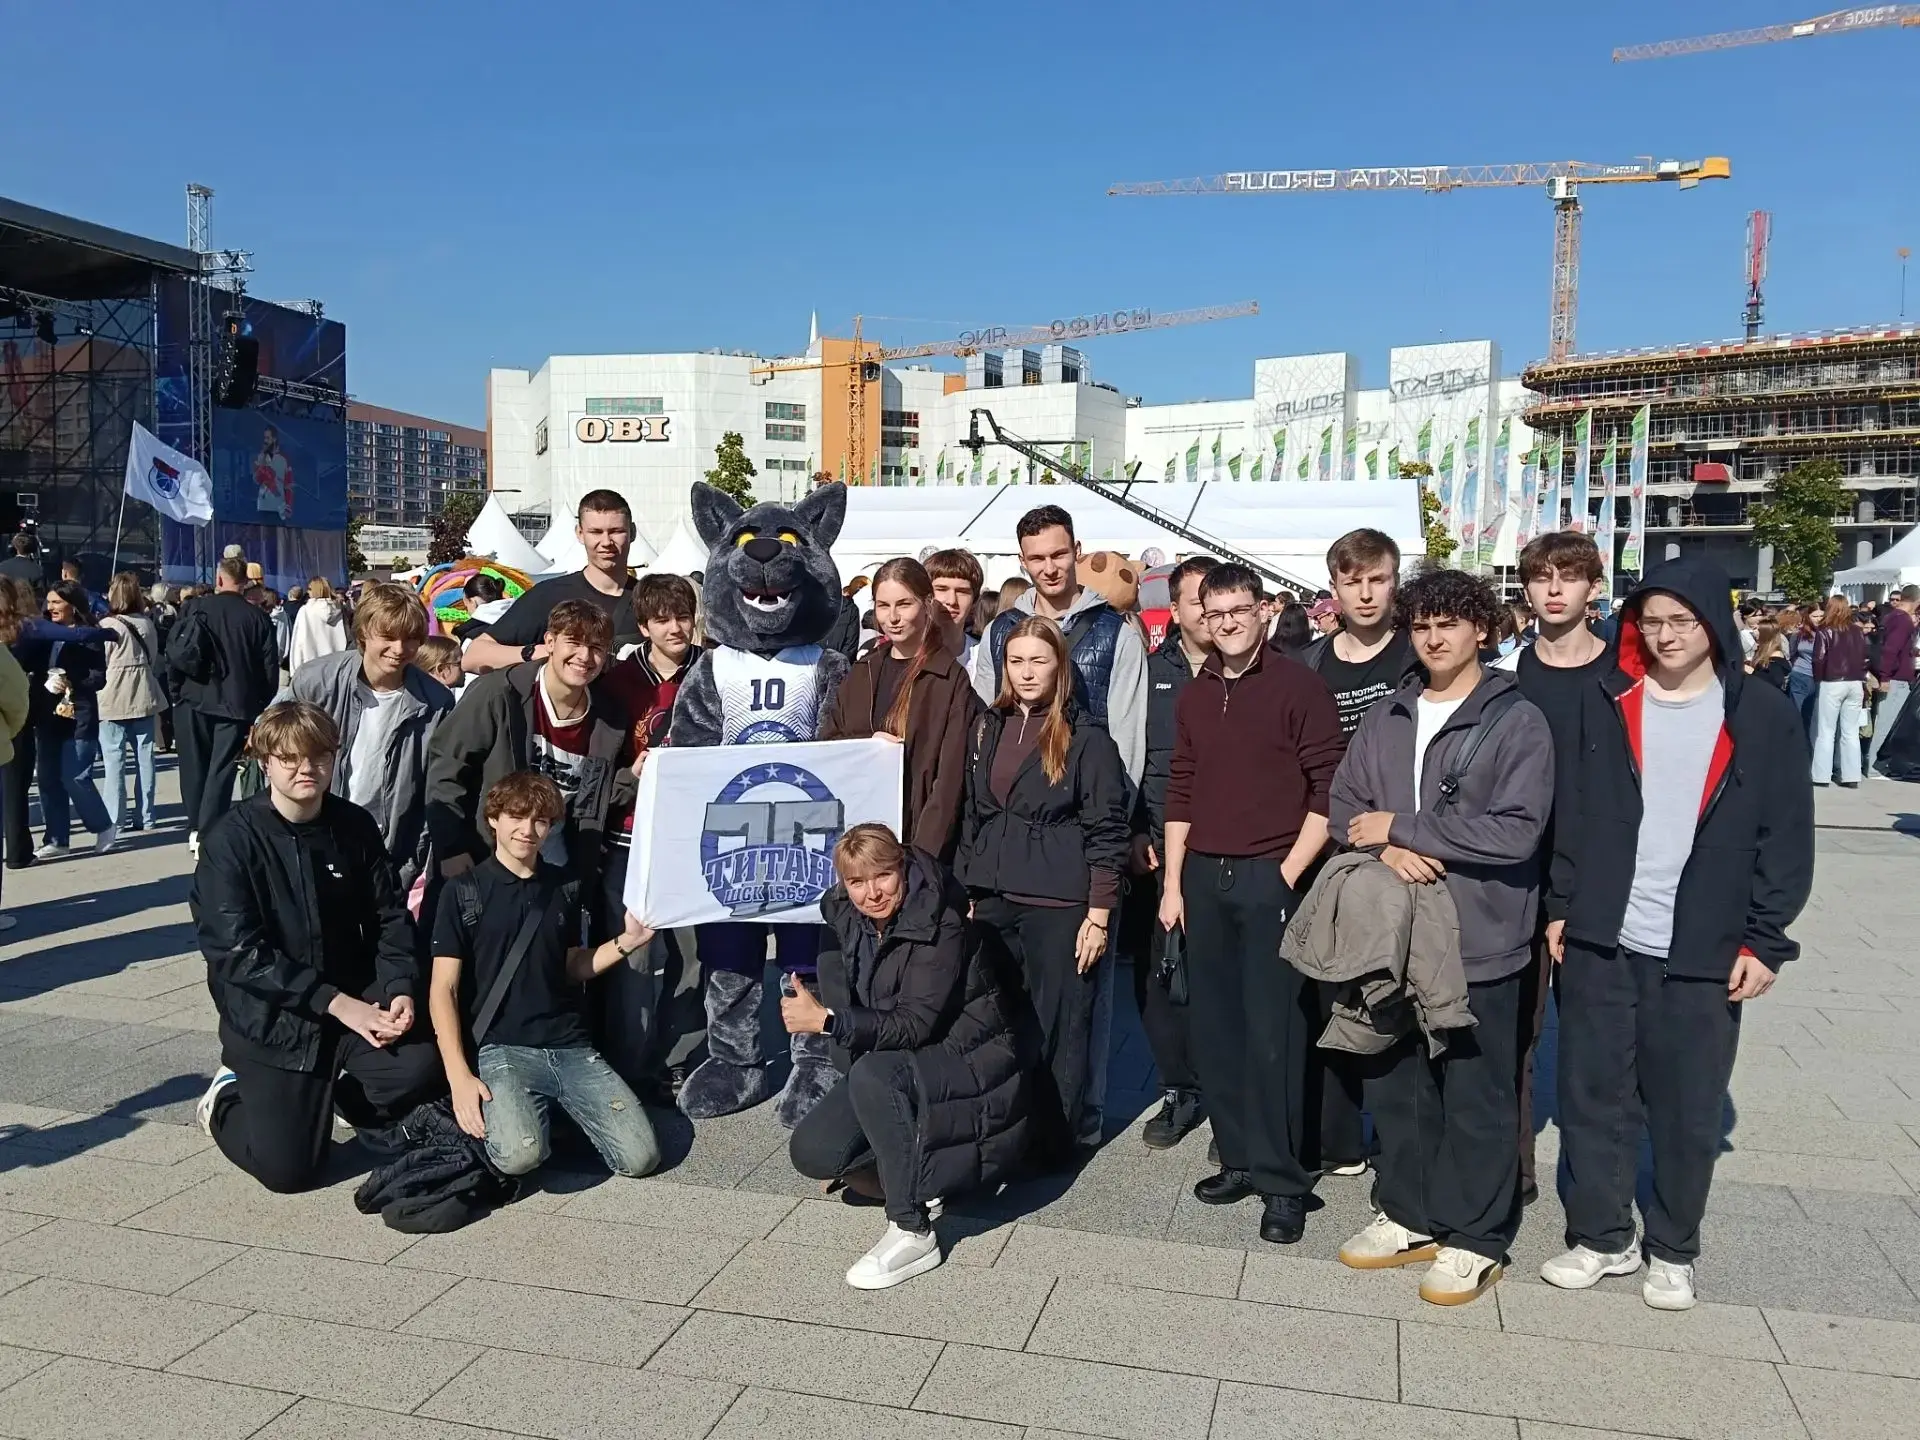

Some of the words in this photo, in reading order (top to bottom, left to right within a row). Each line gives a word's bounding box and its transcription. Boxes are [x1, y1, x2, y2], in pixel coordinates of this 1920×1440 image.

[1051, 307, 1152, 337] ОФИСЫ
[576, 417, 670, 443] OBI
[750, 678, 786, 711] 10
[705, 847, 835, 892] ТИТАН
[767, 884, 808, 903] 1569
